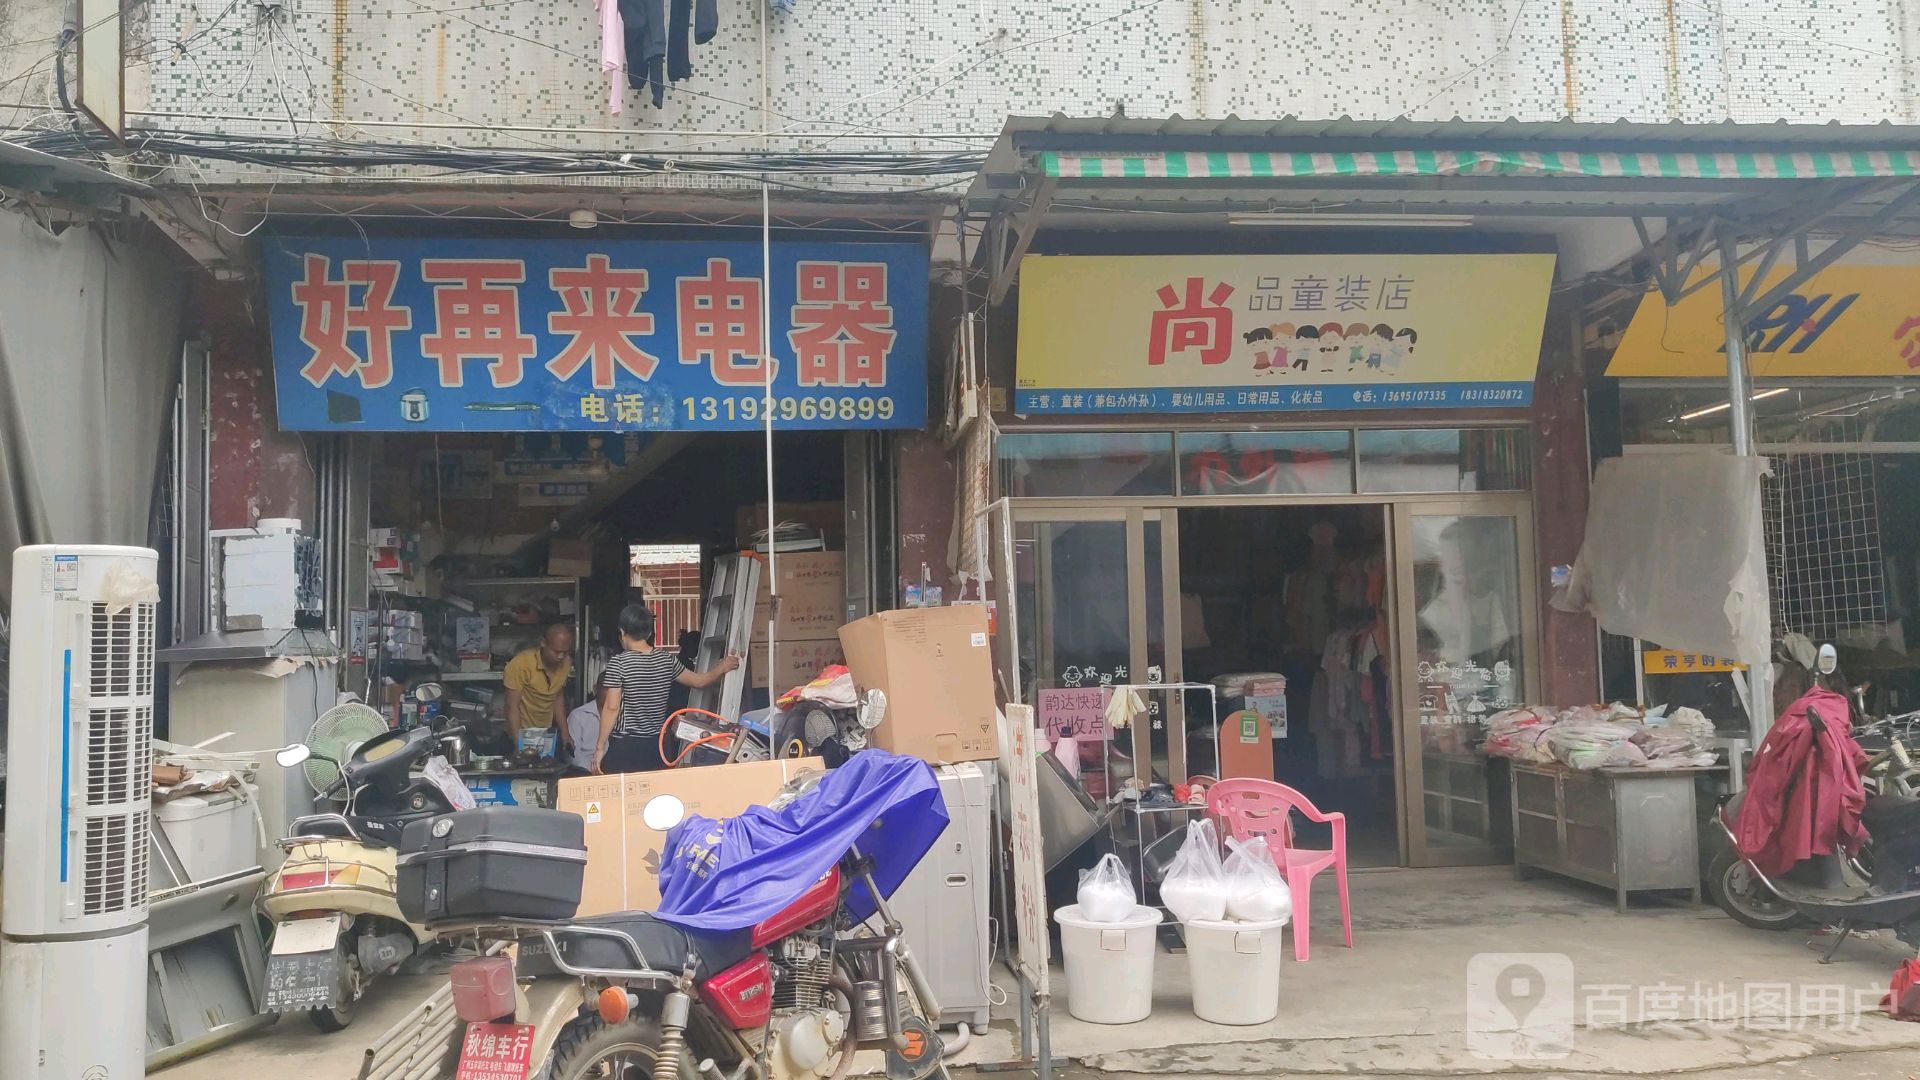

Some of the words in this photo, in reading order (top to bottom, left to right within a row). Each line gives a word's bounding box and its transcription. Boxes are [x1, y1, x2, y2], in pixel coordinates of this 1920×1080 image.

[291, 252, 898, 389] 好再来电器
[1148, 277, 1235, 366] 尚
[1248, 273, 1415, 313] 品童装店
[682, 396, 895, 422] 13192969899
[465, 1032, 529, 1061] 秋绵车行
